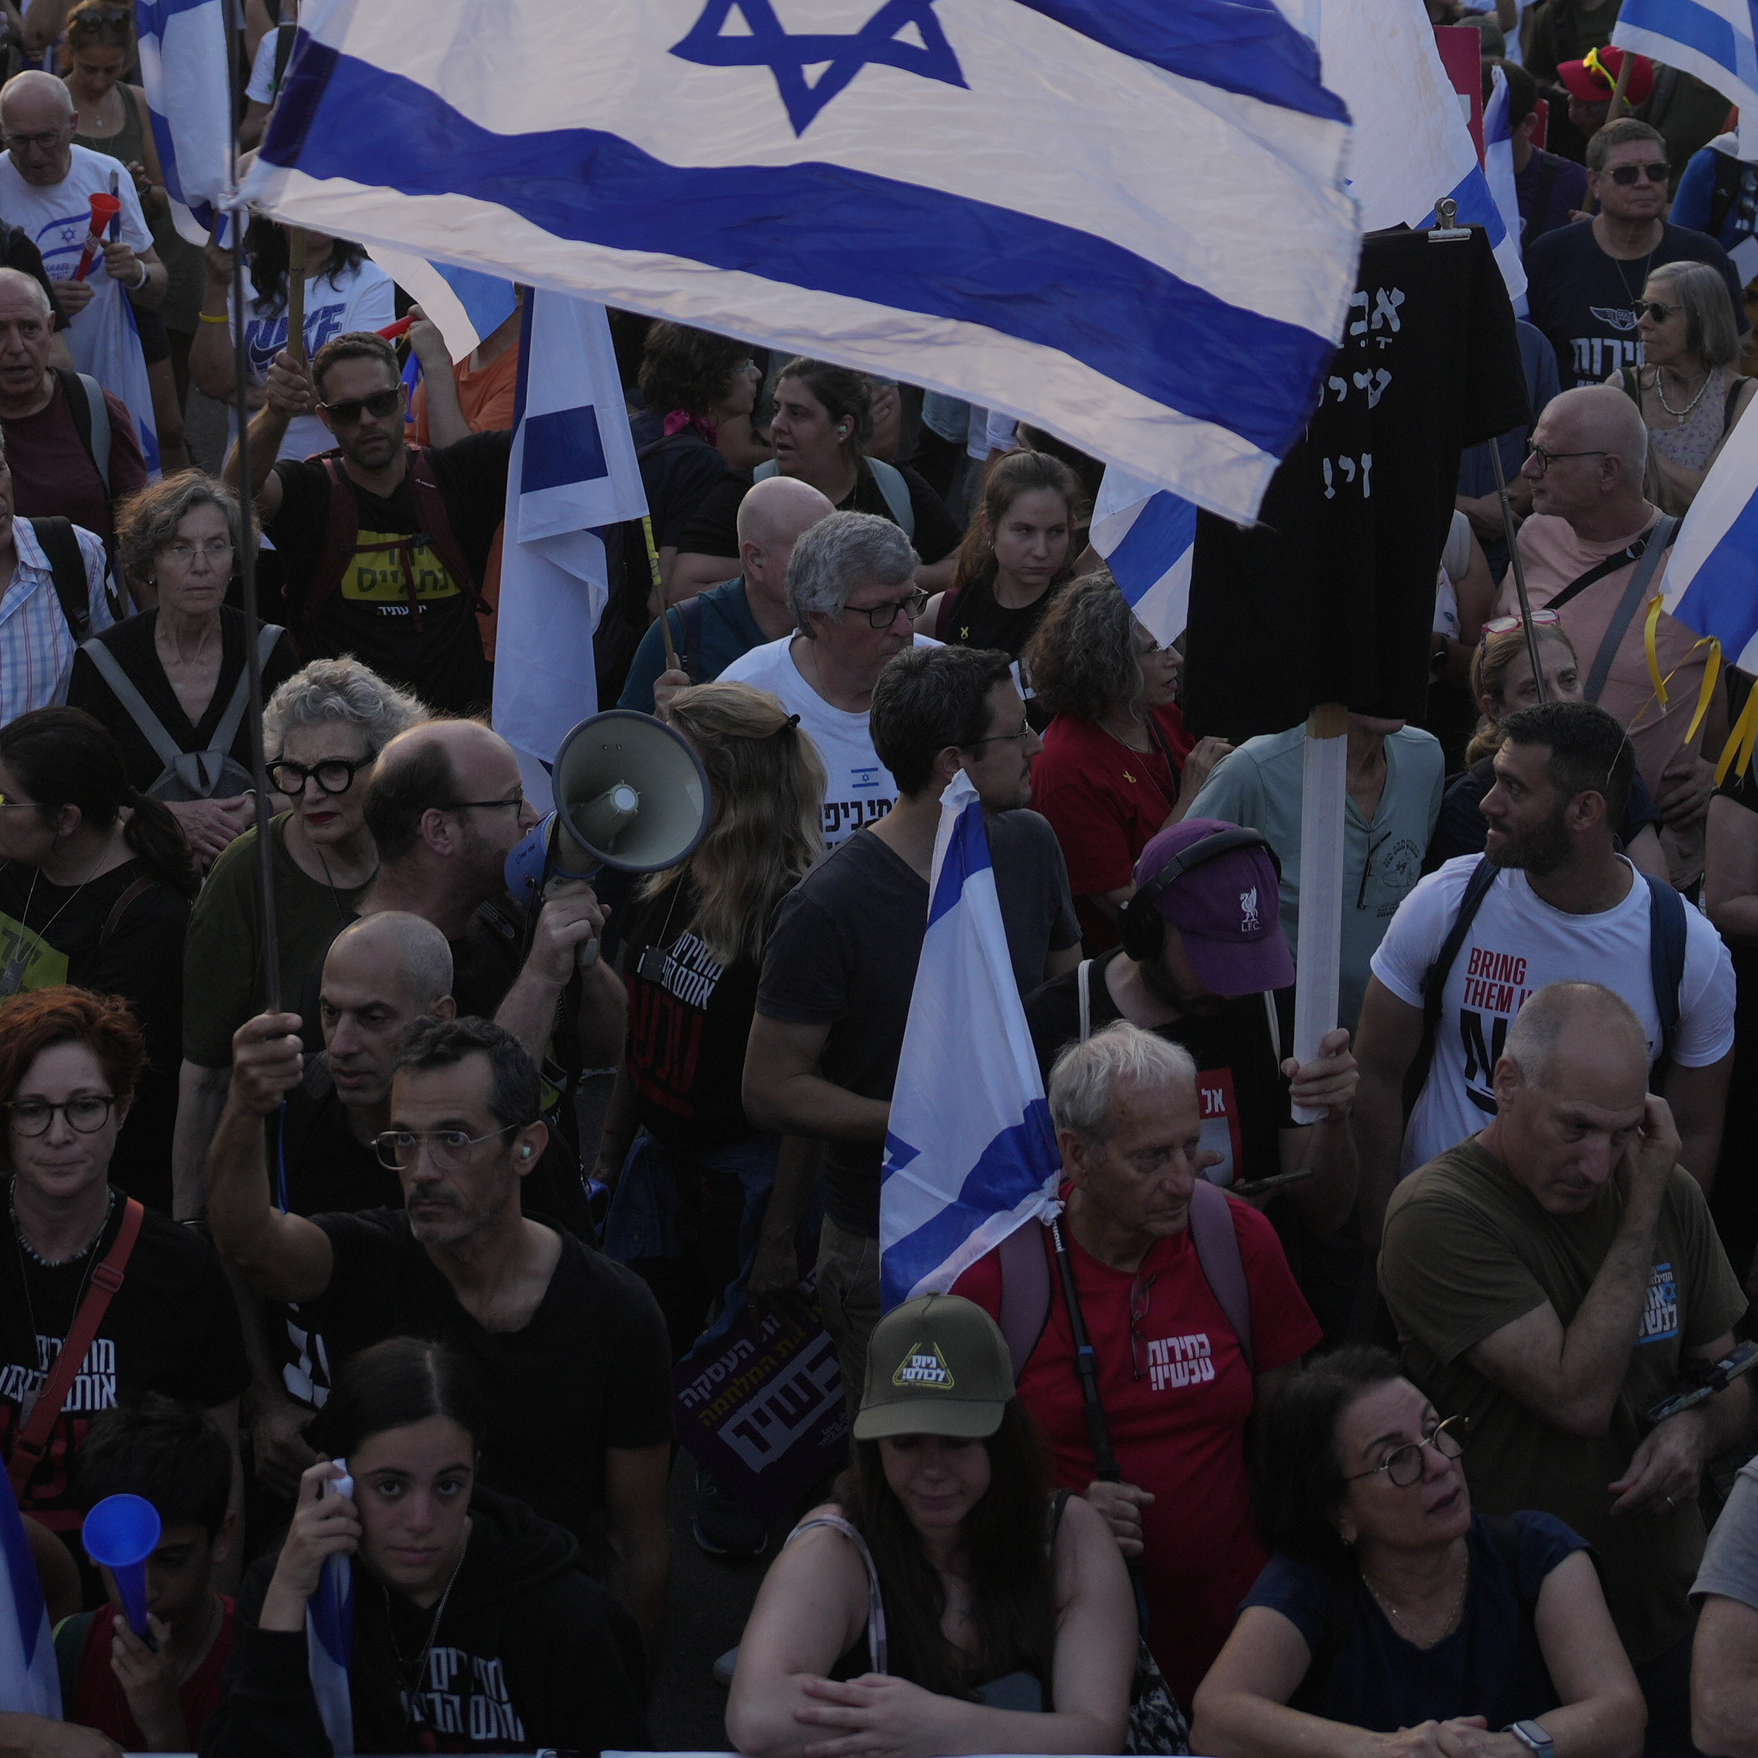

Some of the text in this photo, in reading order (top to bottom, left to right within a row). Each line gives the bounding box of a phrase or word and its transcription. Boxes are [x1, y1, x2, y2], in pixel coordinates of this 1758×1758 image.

[1467, 947, 1527, 985] BRING
[1463, 977, 1514, 1014] THEM
[1200, 1088, 1226, 1114] אל
[1147, 1333, 1212, 1366] בחירות
[678, 1338, 755, 1409] העסקה
[698, 1351, 774, 1429] המלחמה
[902, 1367, 945, 1382] לכולם!
[1149, 1356, 1215, 1391] עכשיו!
